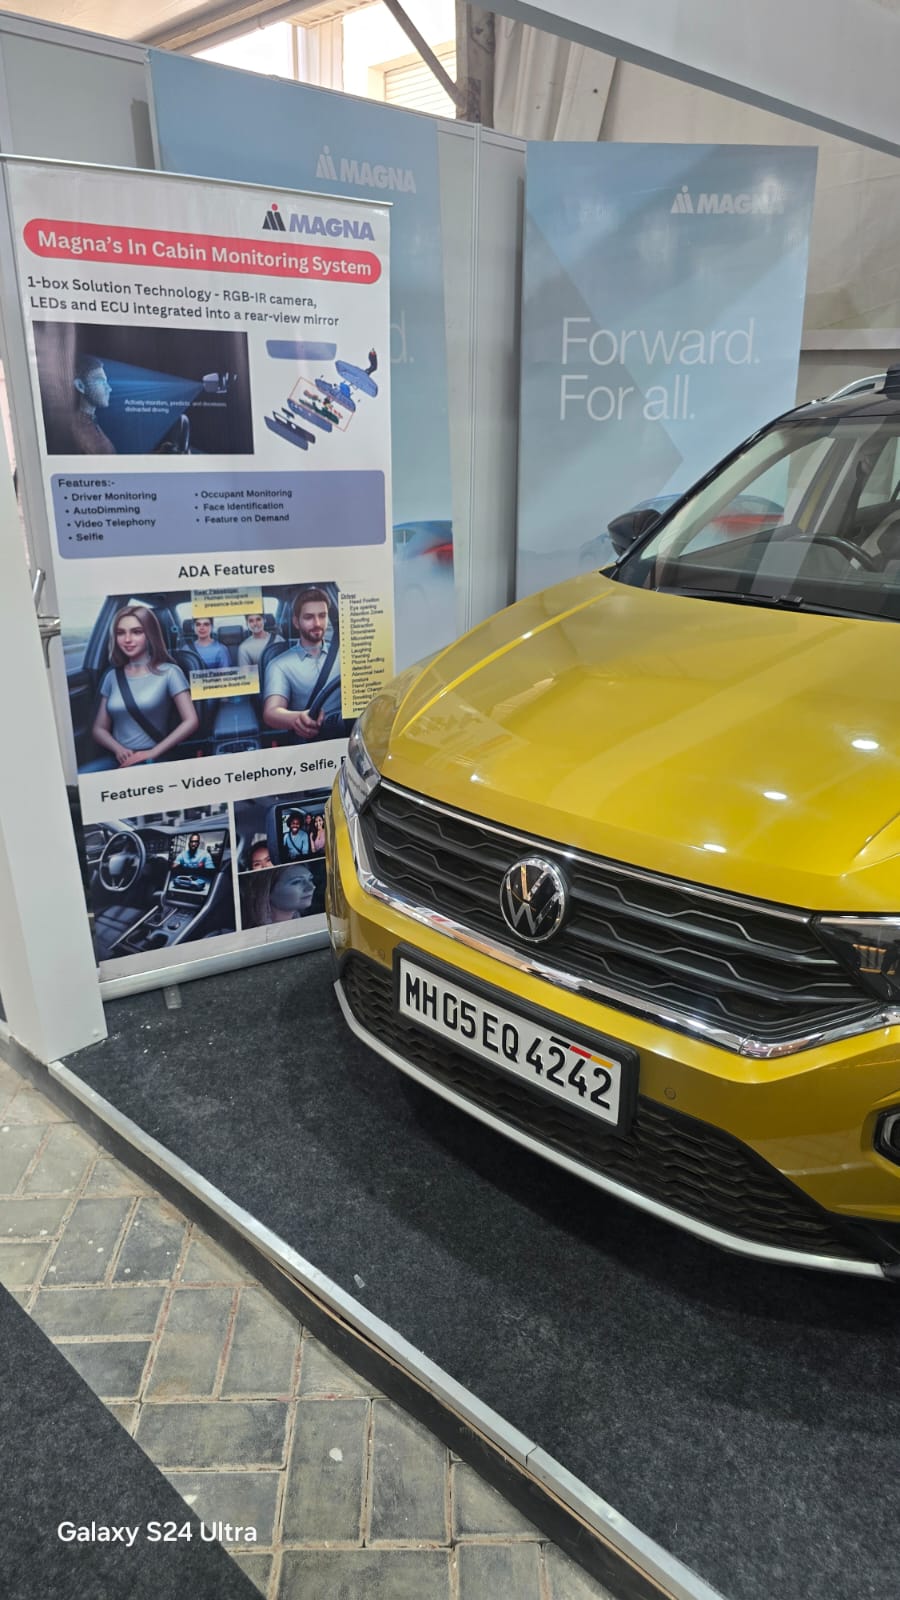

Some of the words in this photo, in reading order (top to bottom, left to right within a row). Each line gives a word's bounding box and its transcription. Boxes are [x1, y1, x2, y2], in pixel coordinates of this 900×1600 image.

[341, 158, 416, 194] MAGNA
[289, 213, 376, 241] MAGNA
[38, 230, 123, 254] Magna's
[128, 239, 147, 256] In
[152, 240, 206, 261] Cabin
[211, 246, 309, 274] Monitoring
[312, 256, 372, 276] System
[28, 276, 68, 290] 1-box
[72, 278, 132, 294] Solution
[135, 283, 212, 303] Technology
[223, 290, 266, 304] RGB-IR
[270, 294, 318, 309] camera,
[30, 296, 68, 310] LEDs
[71, 299, 97, 312] and
[100, 301, 129, 314] ECU
[133, 302, 202, 318] integrated
[206, 307, 230, 320] into
[234, 312, 242, 320] a
[244, 310, 300, 324] rear-view
[304, 314, 339, 326] mirror
[561, 317, 760, 365] Forward.
[560, 374, 634, 420] For
[643, 374, 696, 420] all.
[72, 492, 102, 501] Driver
[104, 492, 157, 501] Monitoring
[200, 490, 244, 499] Occupant
[246, 488, 292, 498] Monitoring
[74, 505, 140, 515] AutoDimming
[203, 503, 224, 511] Face
[227, 502, 284, 510] Identification
[74, 519, 103, 528] Video
[106, 518, 156, 528] Telephony
[204, 516, 238, 524] Feature
[254, 514, 290, 522] Demand
[76, 532, 104, 542] Selfie
[178, 565, 210, 578] ADA
[214, 564, 276, 576] Features
[100, 784, 164, 802] Features
[181, 773, 222, 790] Video
[225, 765, 297, 782] Telephony,
[300, 758, 337, 773] Selfie,
